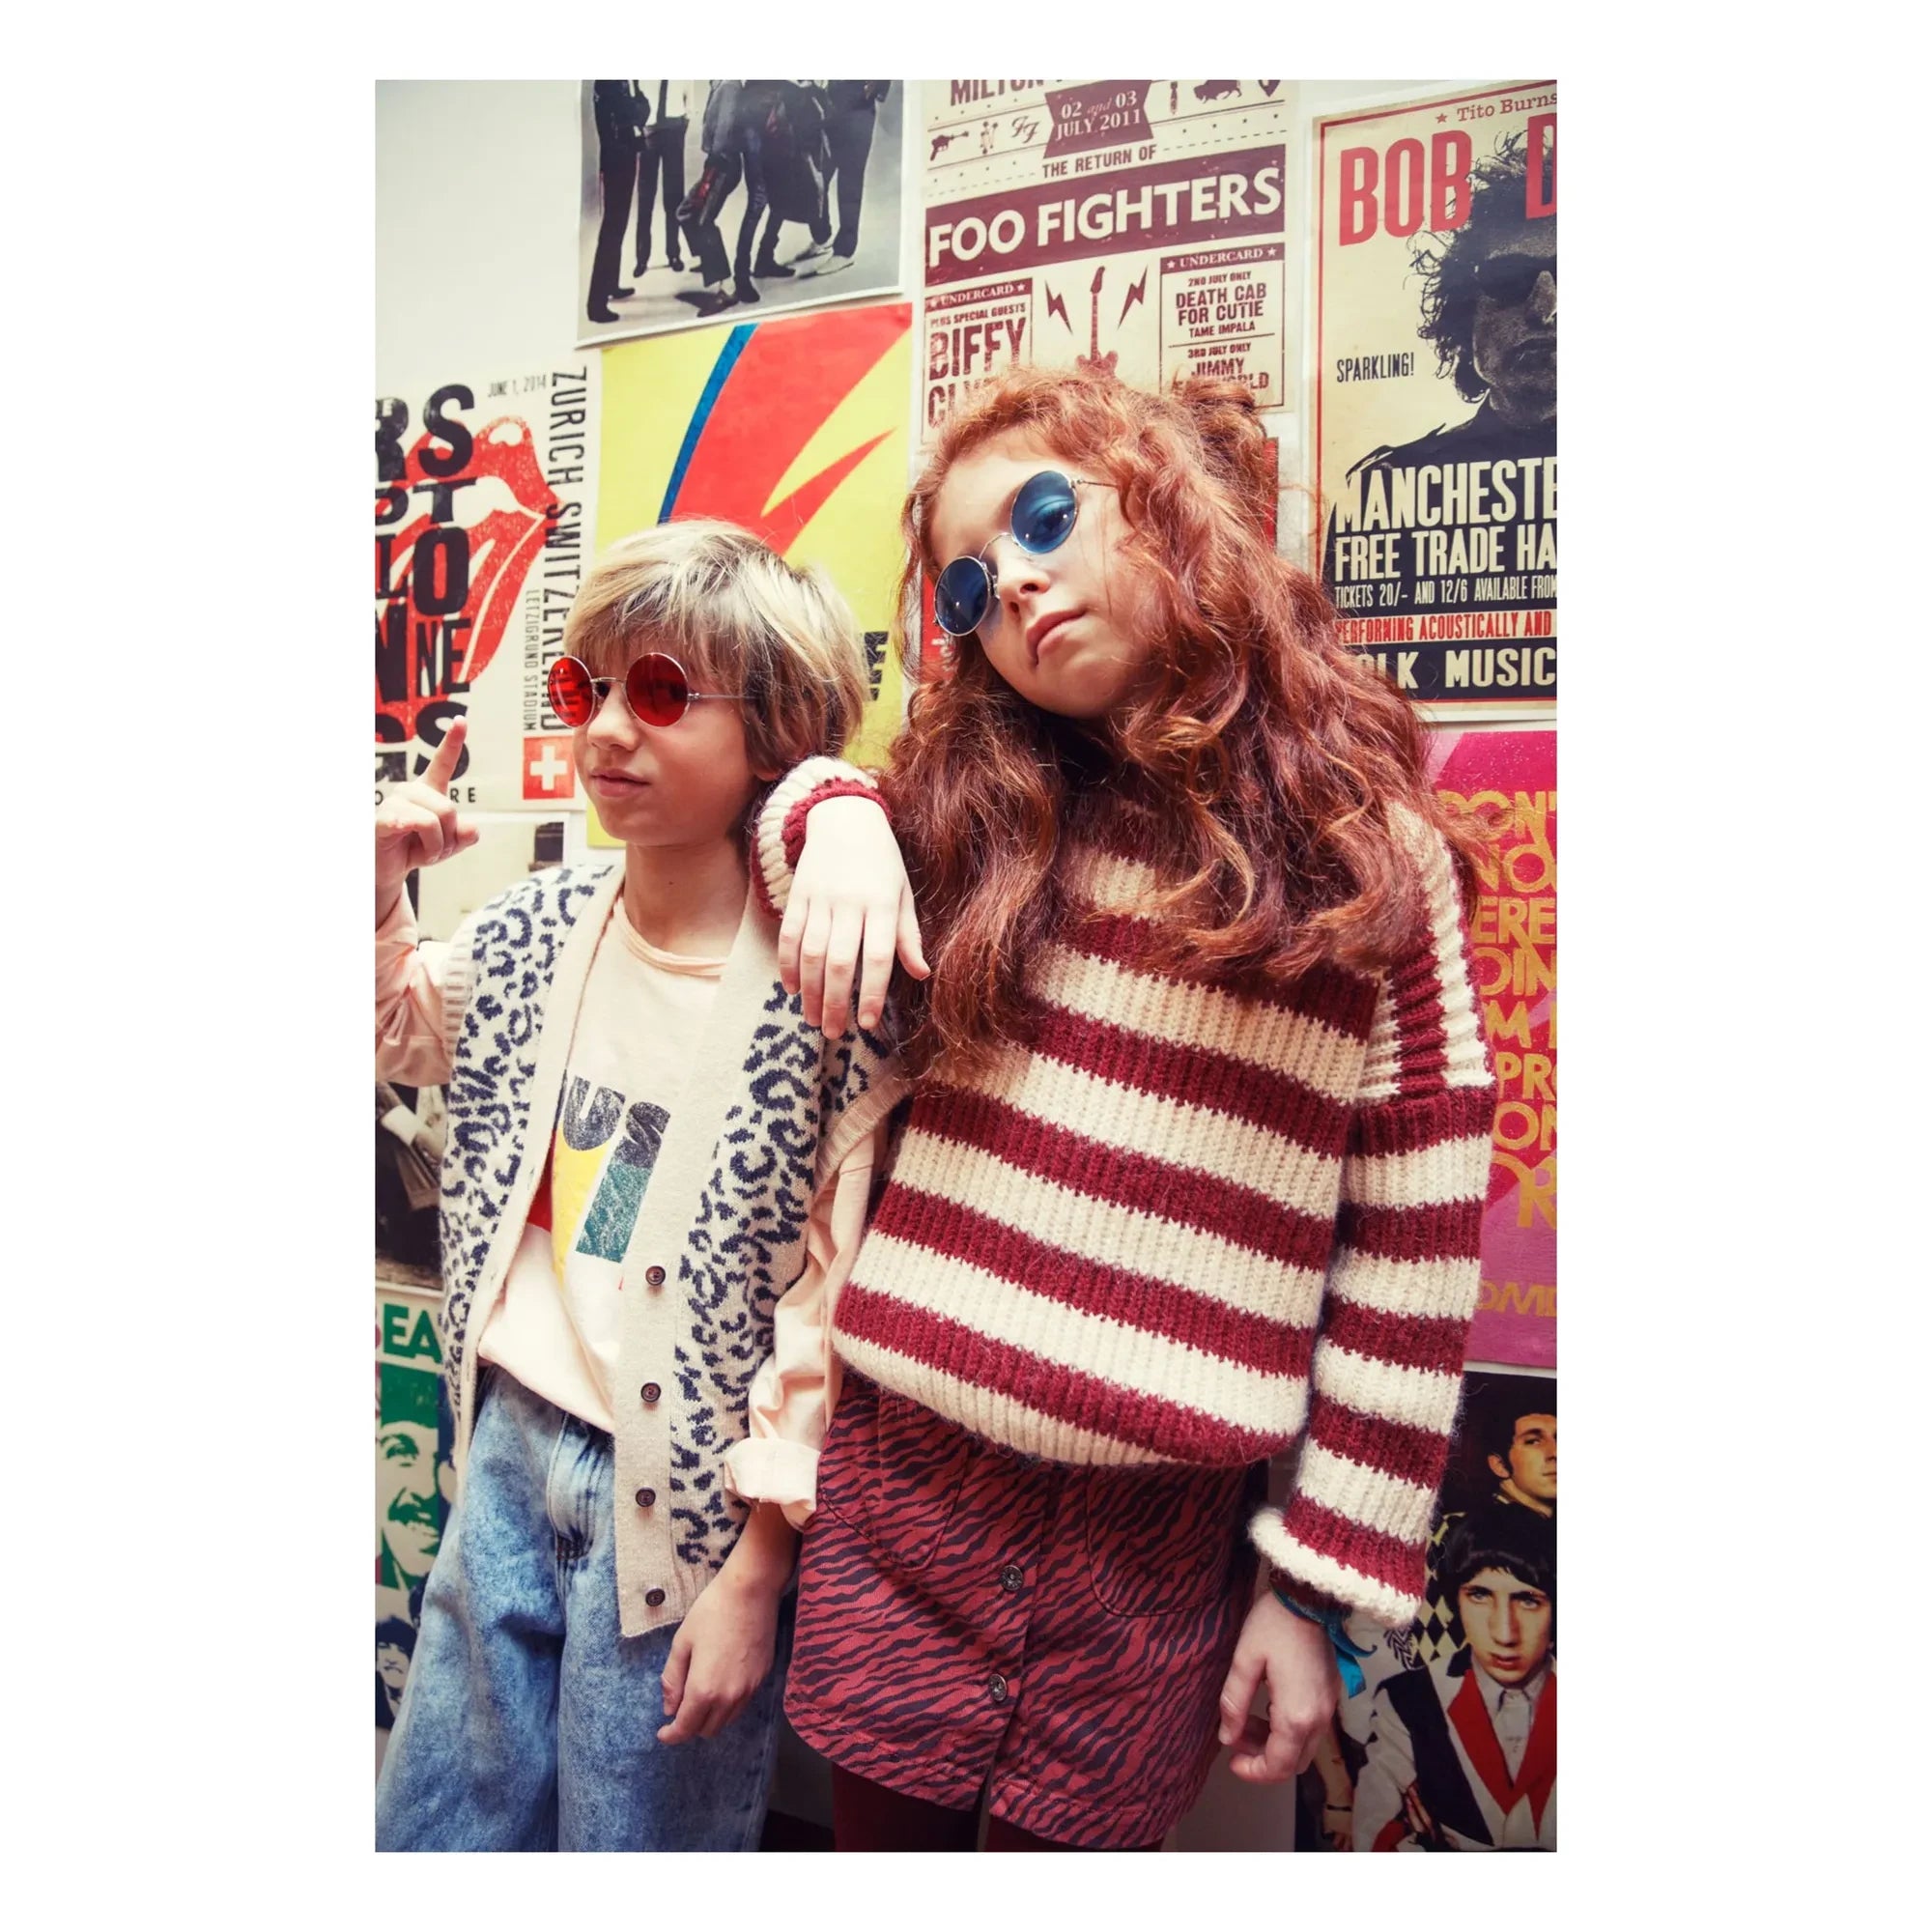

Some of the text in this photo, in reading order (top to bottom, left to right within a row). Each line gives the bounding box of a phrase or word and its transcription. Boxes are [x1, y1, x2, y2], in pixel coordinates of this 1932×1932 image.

[1061, 100, 1083, 120] 02
[1115, 90, 1138, 108] 03
[1457, 93, 1557, 122] Tito Burns
[1055, 107, 1142, 141] JULY 2011
[1042, 144, 1157, 180] THE RETURN OF
[1339, 129, 1472, 246] BOB
[928, 166, 1282, 269] FOO FIGHTERS
[1179, 247, 1264, 269] UNDERCARD
[939, 283, 1013, 306] UNDERCARD
[1188, 270, 1252, 287] 2ND JULY ONLY
[1175, 283, 1267, 309] DEATH CAB
[953, 309, 989, 325] SPECIAL
[991, 302, 1026, 317] GUESTS
[1178, 299, 1264, 327] FOR CUTIE
[1189, 321, 1256, 338] TAME IMPALA
[929, 317, 1027, 381] BIFFY
[1187, 342, 1252, 358] 3RD JULY ONLY
[1191, 357, 1244, 376] JIMMY
[1336, 353, 1414, 384] SPARKLING!
[548, 366, 587, 487] ZURICH
[1335, 456, 1557, 533] MANCHESTE
[1335, 523, 1557, 582] FREE TRADE HA
[1334, 582, 1373, 610] TICKETS
[1414, 580, 1435, 605] AND
[1441, 578, 1468, 604] 12/6
[1474, 576, 1528, 602] AVAILABLE
[1530, 575, 1557, 599] FROM
[1335, 610, 1551, 644] PERFORMING ACOUSTICALLY AND
[1445, 647, 1556, 689] MUSIC
[523, 674, 539, 731] STADIUM
